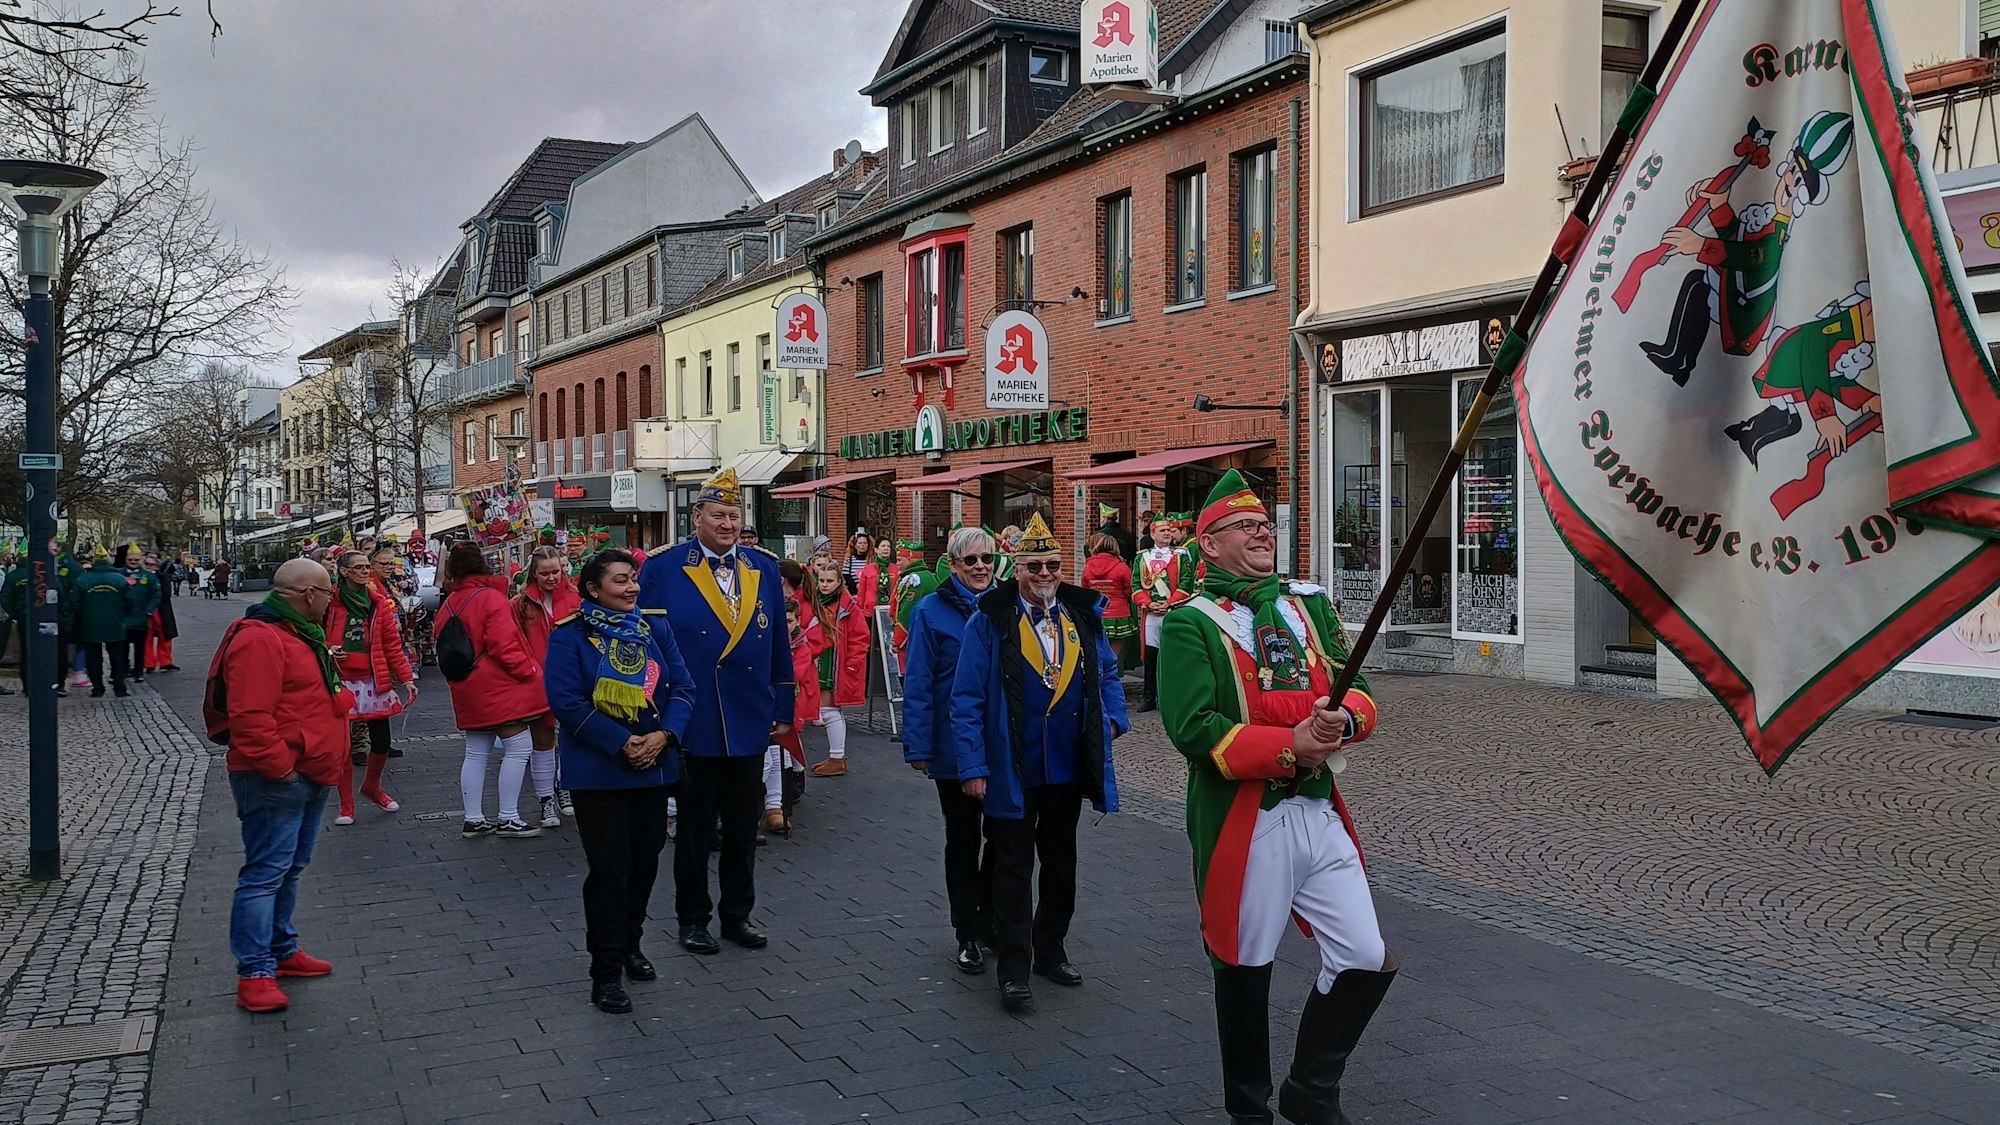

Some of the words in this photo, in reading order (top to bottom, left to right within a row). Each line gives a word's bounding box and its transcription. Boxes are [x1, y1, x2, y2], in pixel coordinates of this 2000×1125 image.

[1095, 52, 1132, 64] Marien
[1089, 64, 1139, 79] Apotheke
[1573, 148, 1664, 401] Bergheimer
[786, 346, 819, 355] MARIEN
[1382, 329, 1432, 367] ML
[780, 355, 825, 365] APOTHEKE
[1371, 363, 1411, 378] BARBER
[1412, 359, 1439, 374] CLUB
[763, 374, 775, 385] Ihr
[997, 380, 1037, 390] MARIEN
[989, 392, 1045, 403] APOTHEKE
[765, 387, 774, 441] Blumenladen
[839, 427, 916, 459] MARIEN
[948, 406, 1084, 450] APOTHEKE
[619, 478, 634, 490] DEKRA
[1342, 569, 1373, 581] DAMEN
[1472, 574, 1503, 587] AUCH
[1342, 580, 1373, 591] HERREN
[1342, 590, 1373, 600] KINDER
[1472, 586, 1504, 599] OHNE
[1472, 598, 1504, 609] TERMIN
